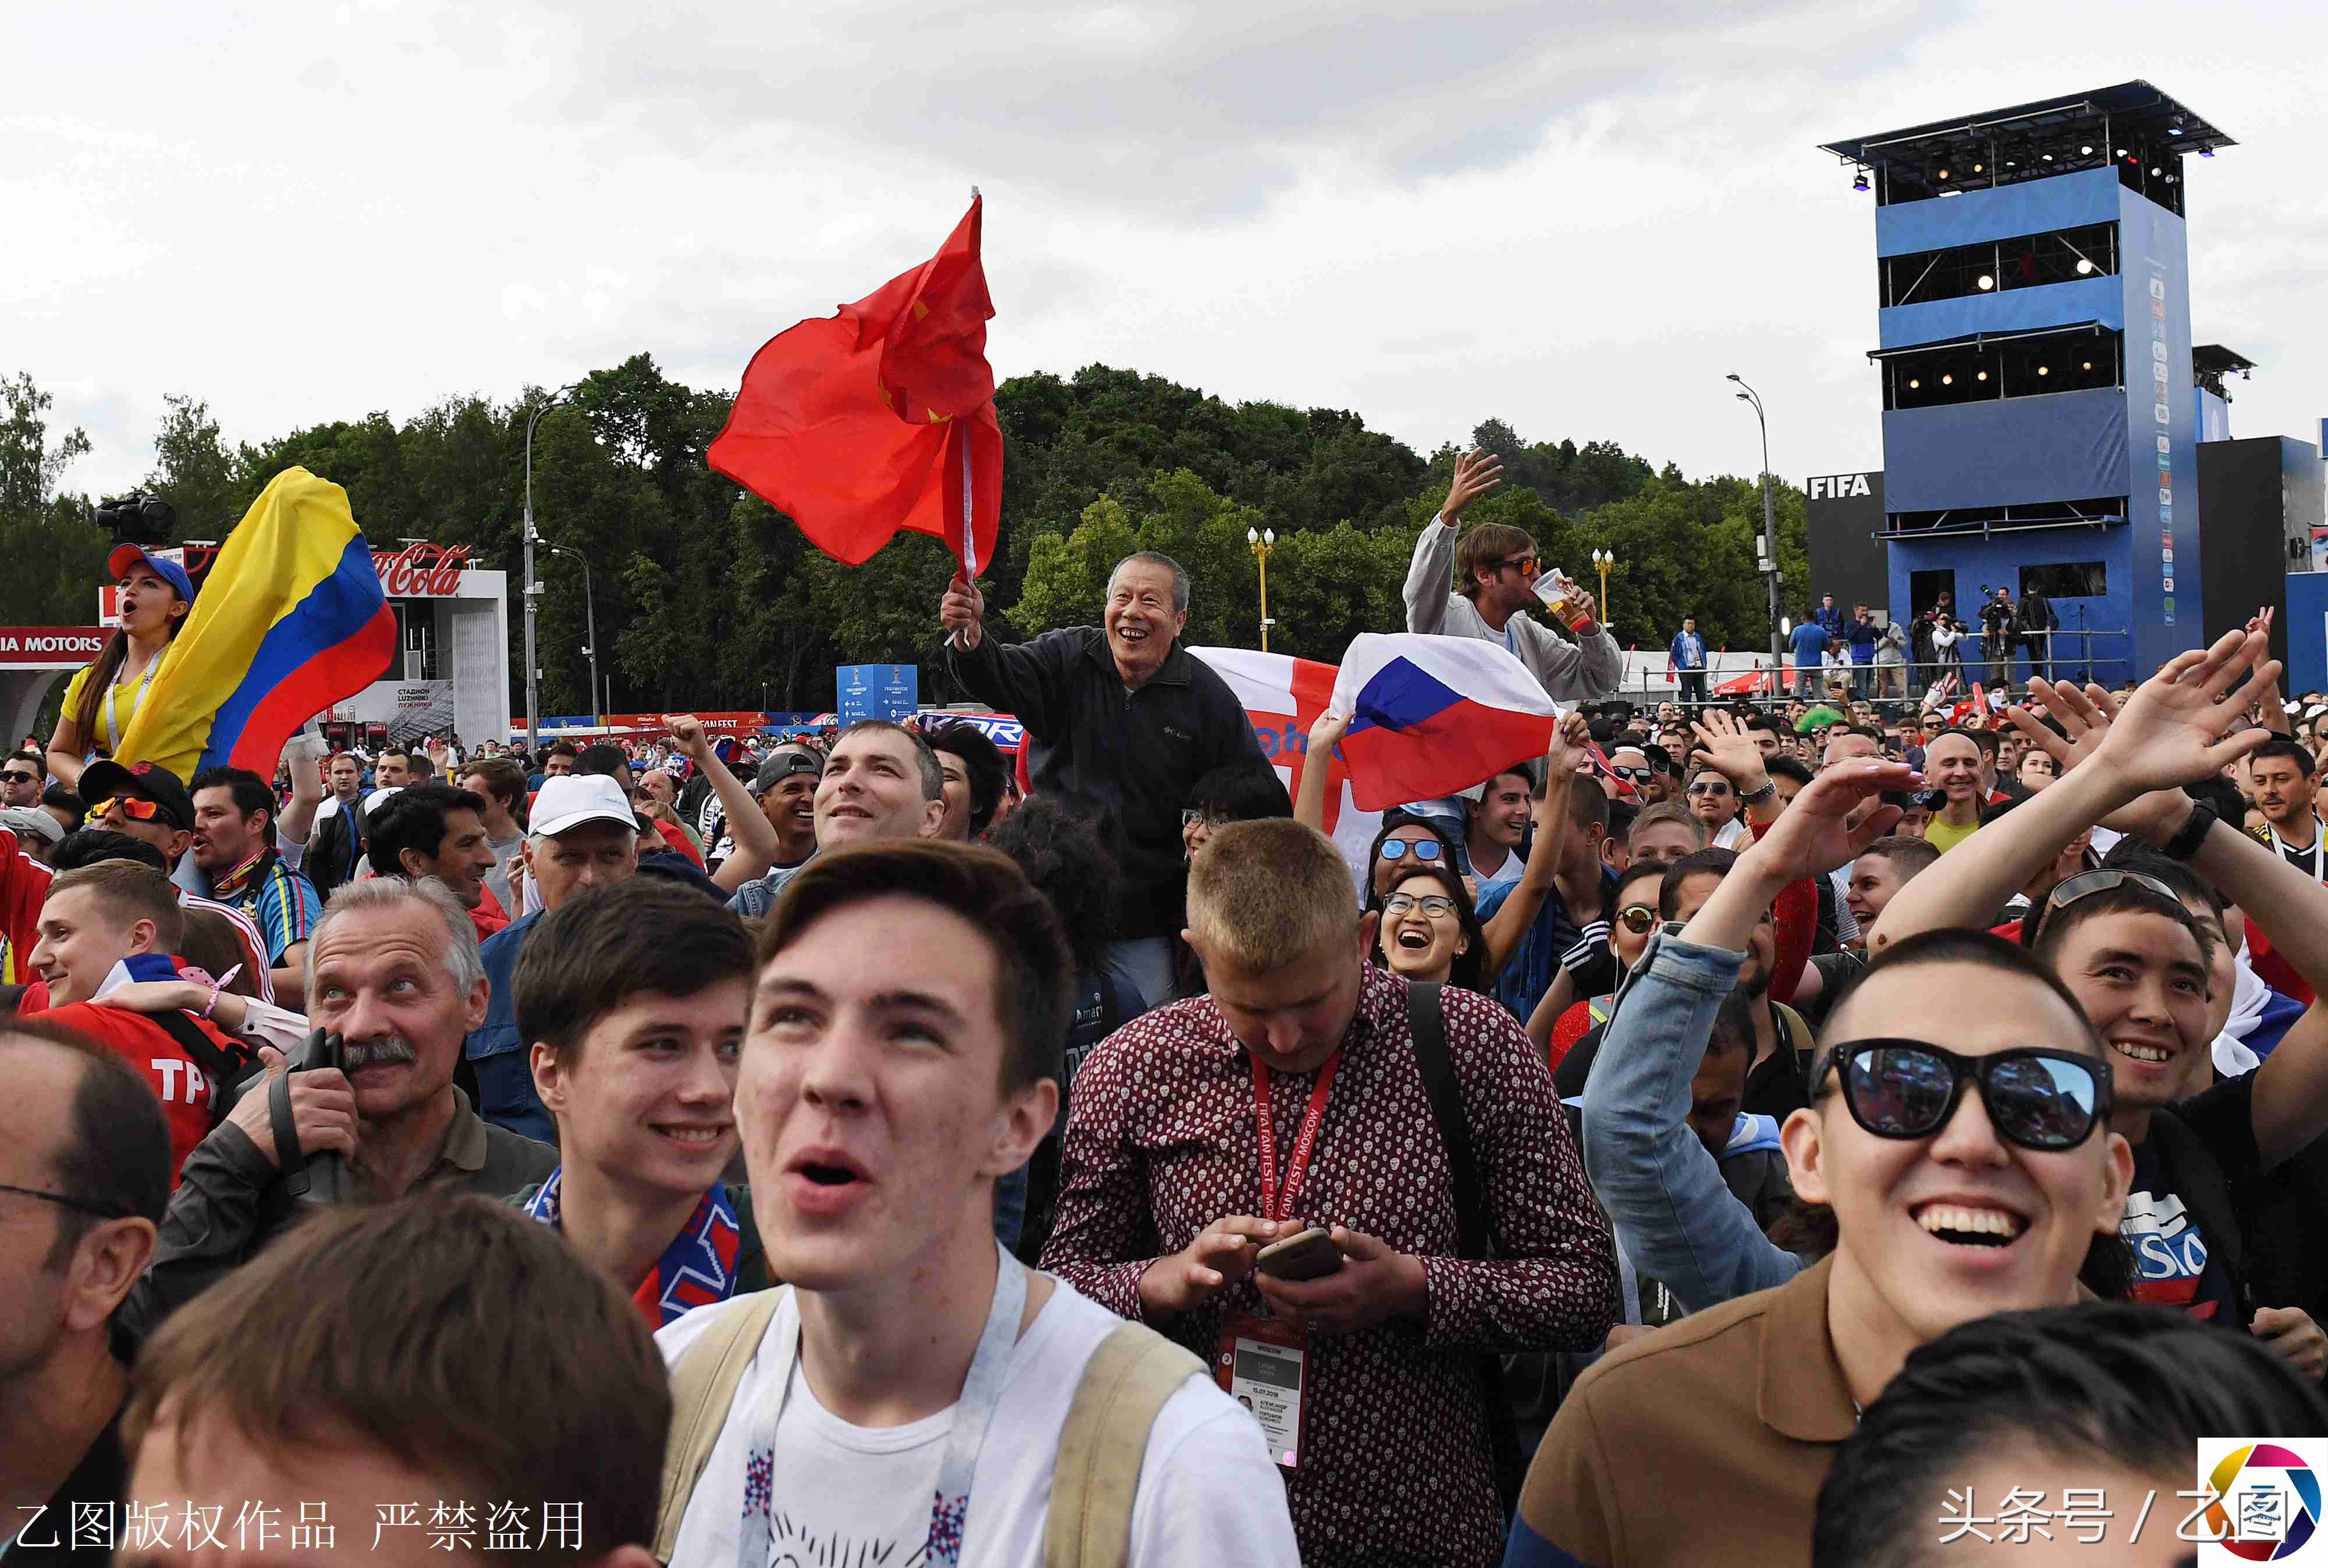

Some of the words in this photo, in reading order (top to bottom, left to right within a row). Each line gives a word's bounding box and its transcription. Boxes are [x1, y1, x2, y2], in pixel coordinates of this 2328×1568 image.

[1811, 474, 1871, 499] FIFA
[0, 637, 19, 652] IA
[24, 637, 102, 652] MOTORS
[700, 719, 717, 728] FAN
[718, 719, 738, 728] FEST
[1259, 1102, 1269, 1127] FIFA
[1261, 1129, 1271, 1154] FAN
[1280, 1193, 1294, 1218] FAN
[1298, 1108, 1319, 1156] MOSCOW
